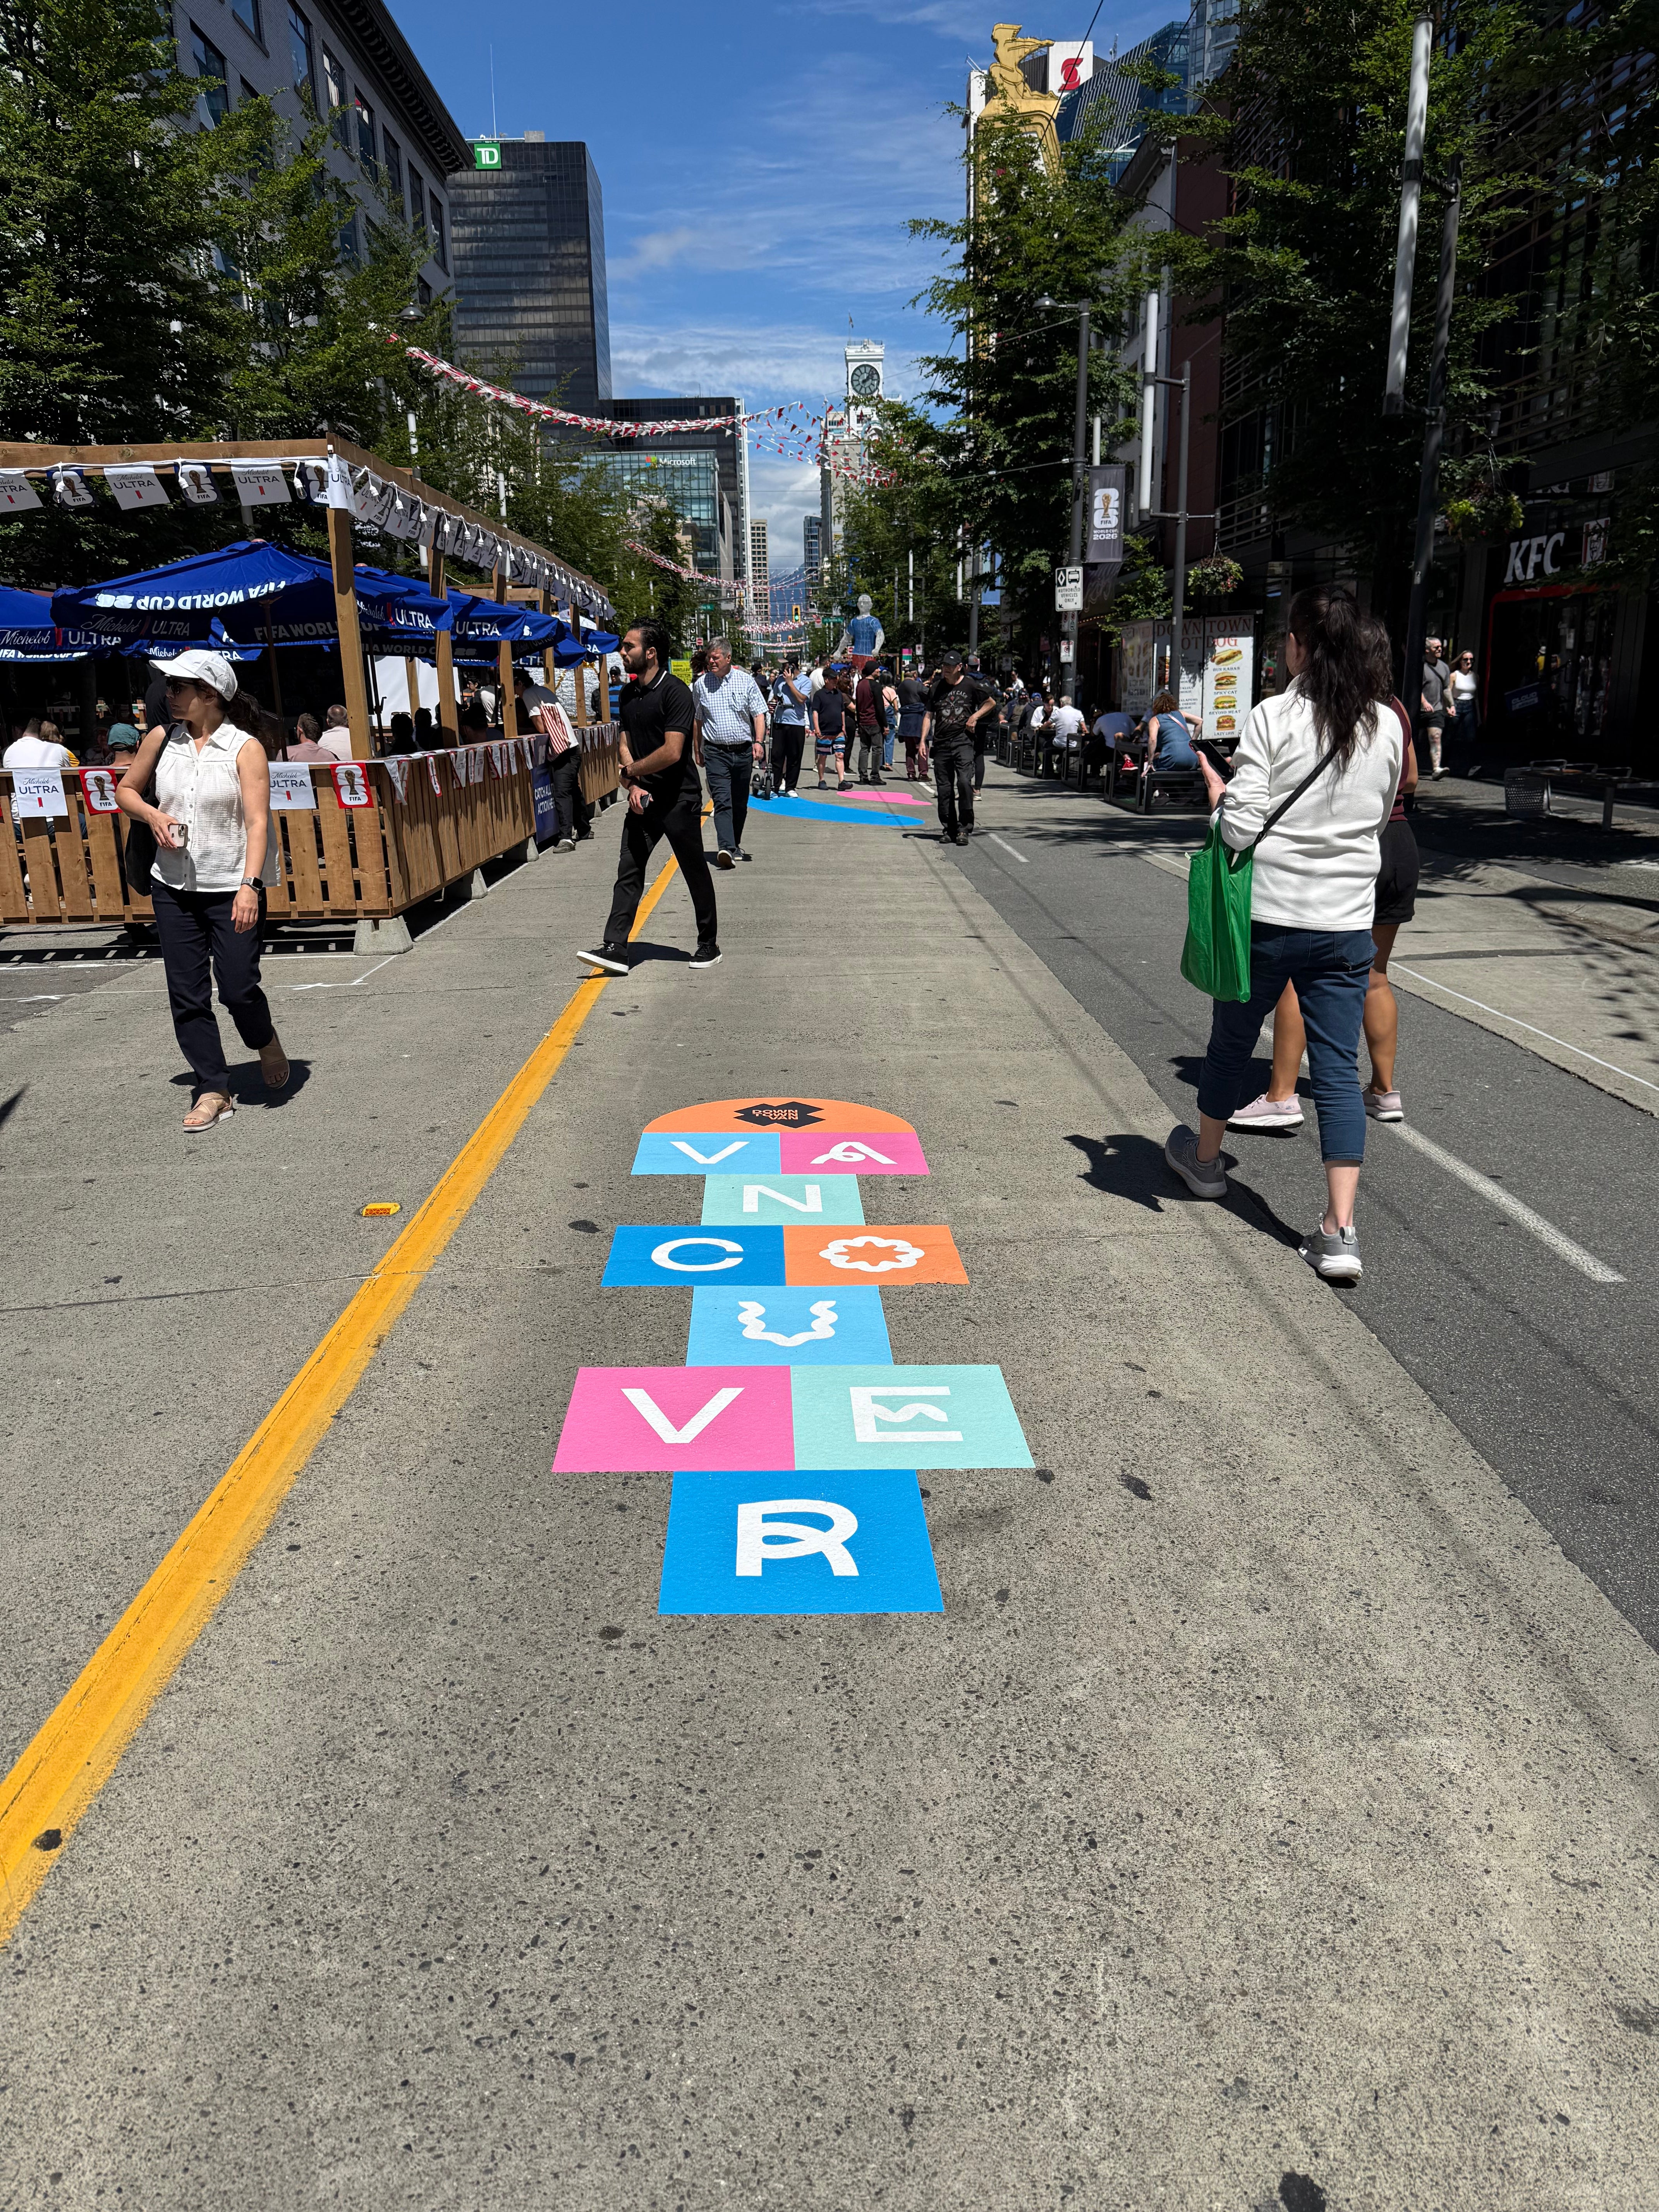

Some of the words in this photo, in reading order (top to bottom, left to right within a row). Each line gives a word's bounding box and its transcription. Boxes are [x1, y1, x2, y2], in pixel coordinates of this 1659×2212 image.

[476, 148, 498, 164] TD
[659, 457, 696, 466] Microsoft
[113, 480, 155, 489] ULTRA
[237, 476, 280, 484] ULTRA
[1503, 532, 1565, 583] KFC
[136, 595, 175, 610] CUP
[178, 589, 244, 610] WORLD
[81, 614, 142, 633] Michelob
[151, 620, 190, 636] ULTRA
[395, 608, 436, 629] ULTRA
[1206, 618, 1251, 633] TOWN
[289, 622, 338, 637] WORL
[455, 621, 502, 637] ULTRA
[68, 630, 122, 646] ULTRA
[1206, 635, 1238, 648] DOG
[382, 644, 427, 654] WORLD
[22, 777, 50, 785] Michelob
[270, 779, 307, 788] ULTRA
[18, 785, 60, 795] ULTRA
[534, 785, 546, 800] CATCH
[537, 799, 550, 815] ACTION
